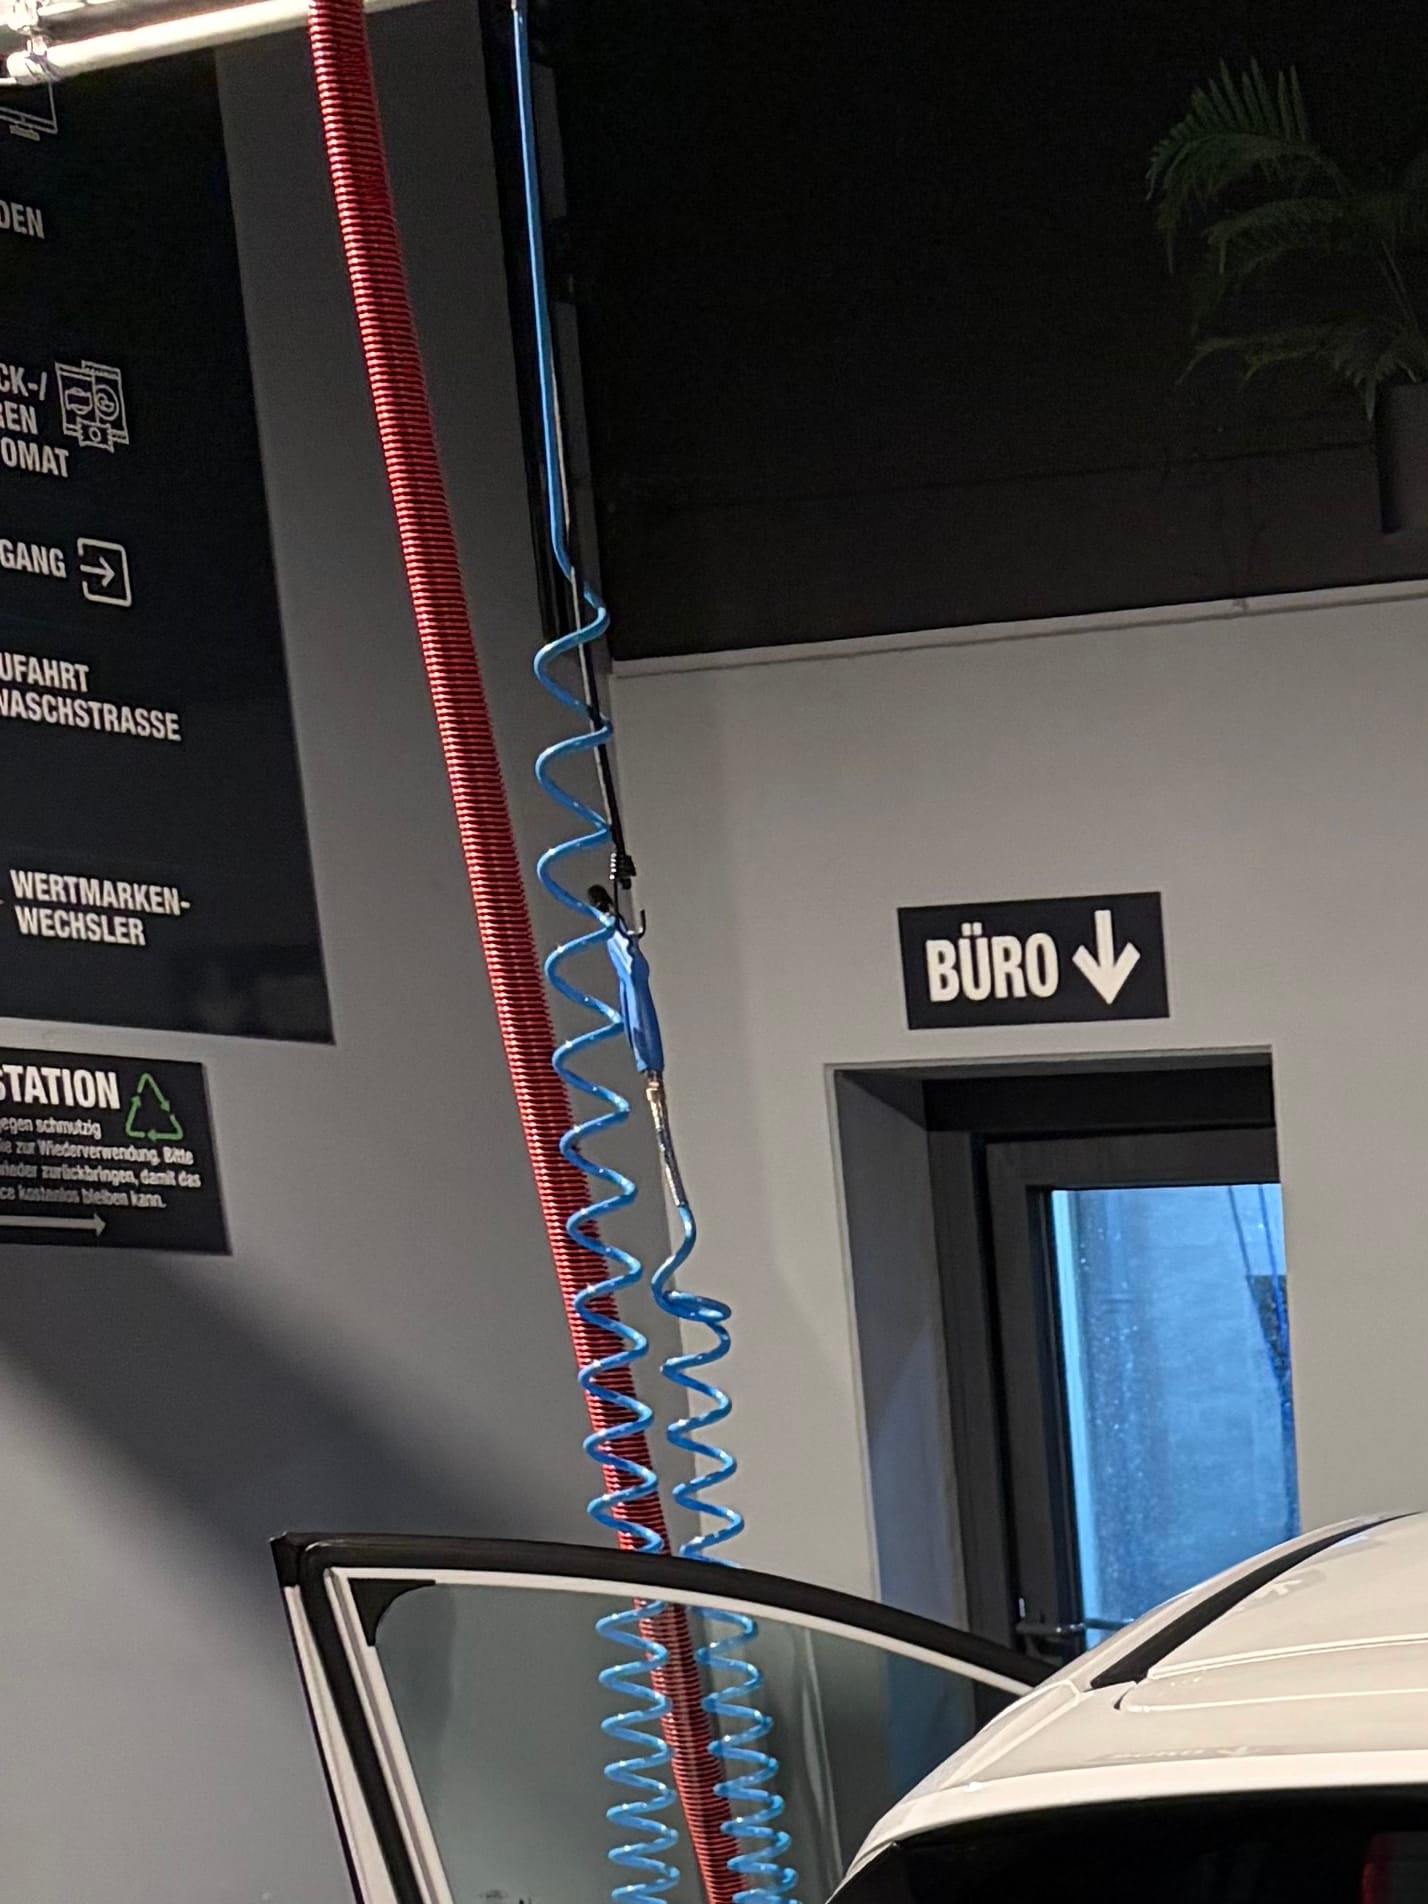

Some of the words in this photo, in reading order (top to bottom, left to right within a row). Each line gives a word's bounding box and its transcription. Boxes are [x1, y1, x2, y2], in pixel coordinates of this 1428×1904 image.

[0, 538, 67, 578] GANG
[9, 868, 191, 916] WERTMARKEN-
[15, 905, 146, 946] WECHSLER
[925, 921, 1059, 1003] BÜRO
[35, 1116, 102, 1140] schmutzig
